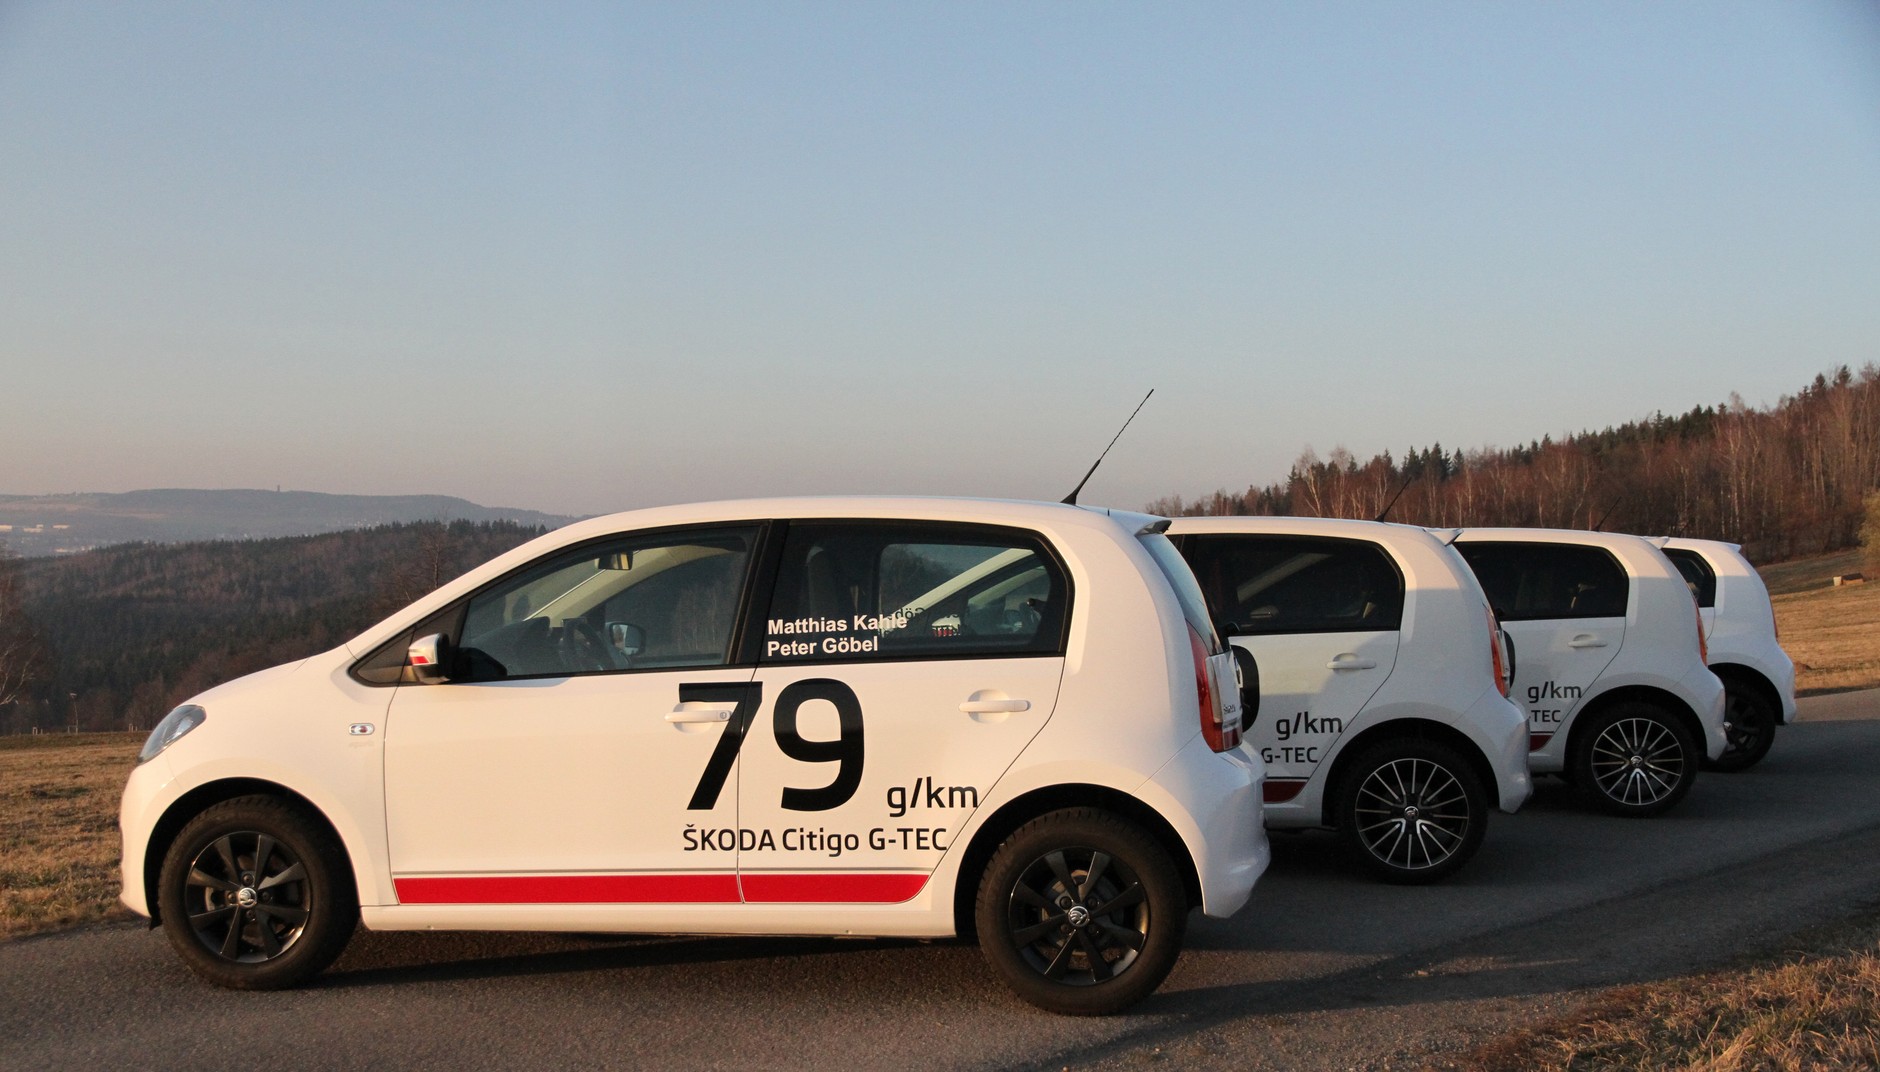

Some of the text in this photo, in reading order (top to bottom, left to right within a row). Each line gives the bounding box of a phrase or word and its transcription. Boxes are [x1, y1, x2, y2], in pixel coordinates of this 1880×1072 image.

[768, 614, 908, 635] Matthias Kahle
[767, 635, 878, 657] Peter Göbel
[1527, 680, 1582, 704] g/km
[1275, 711, 1343, 741] g/km
[679, 678, 978, 817] 79 g/km
[1261, 746, 1318, 764] G-TEC
[682, 823, 948, 858] ŠKODA Citigo G-TEC
